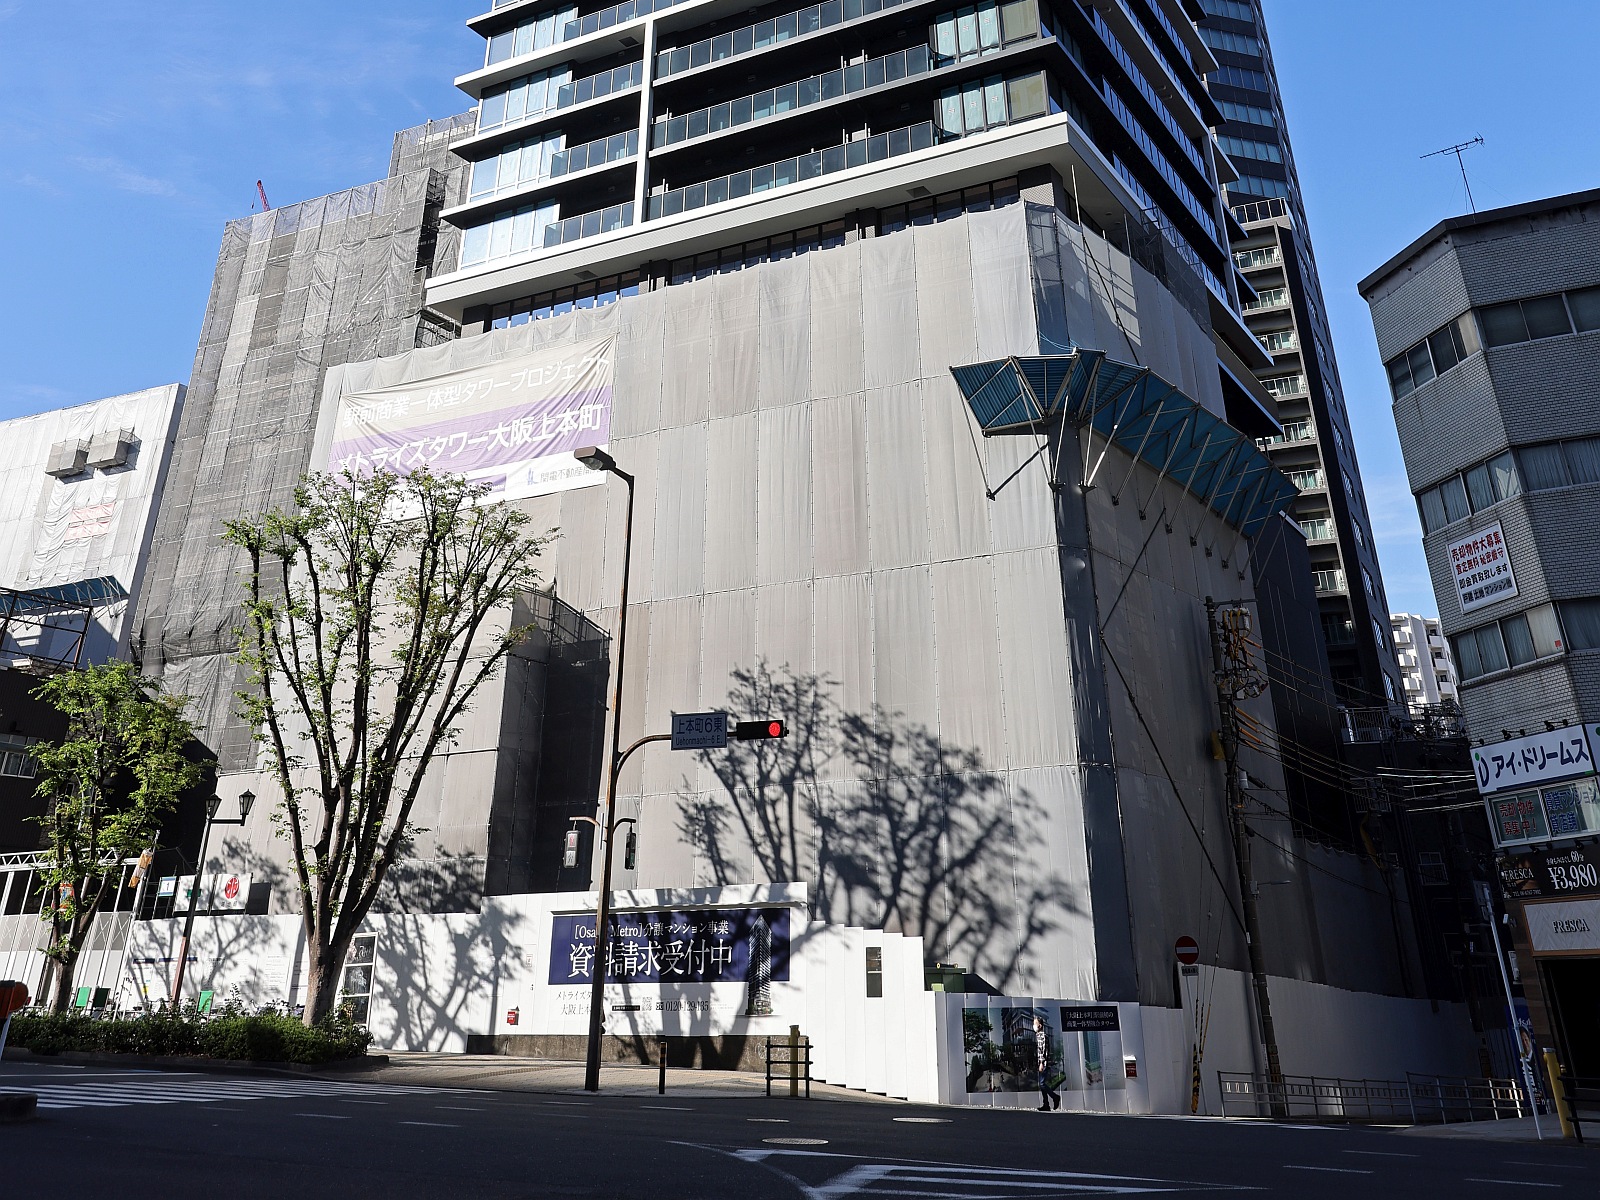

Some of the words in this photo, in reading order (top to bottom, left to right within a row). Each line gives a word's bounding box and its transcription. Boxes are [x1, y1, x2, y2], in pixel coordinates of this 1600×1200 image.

[342, 355, 610, 429] 駅前商業一体型タワープロジェクト
[334, 402, 603, 480] メトライズタワー大阪上本町
[1451, 531, 1502, 562] 売却物件大募集
[1459, 562, 1508, 589] 即金買取致します
[676, 717, 723, 735] 上本町6東
[1491, 738, 1590, 779] アイ・ドリームス
[1499, 799, 1535, 818] 売却物件
[1547, 862, 1599, 891] ¥3,980
[1552, 918, 1590, 934] FRESCA
[556, 990, 593, 1000] メトライズタ
